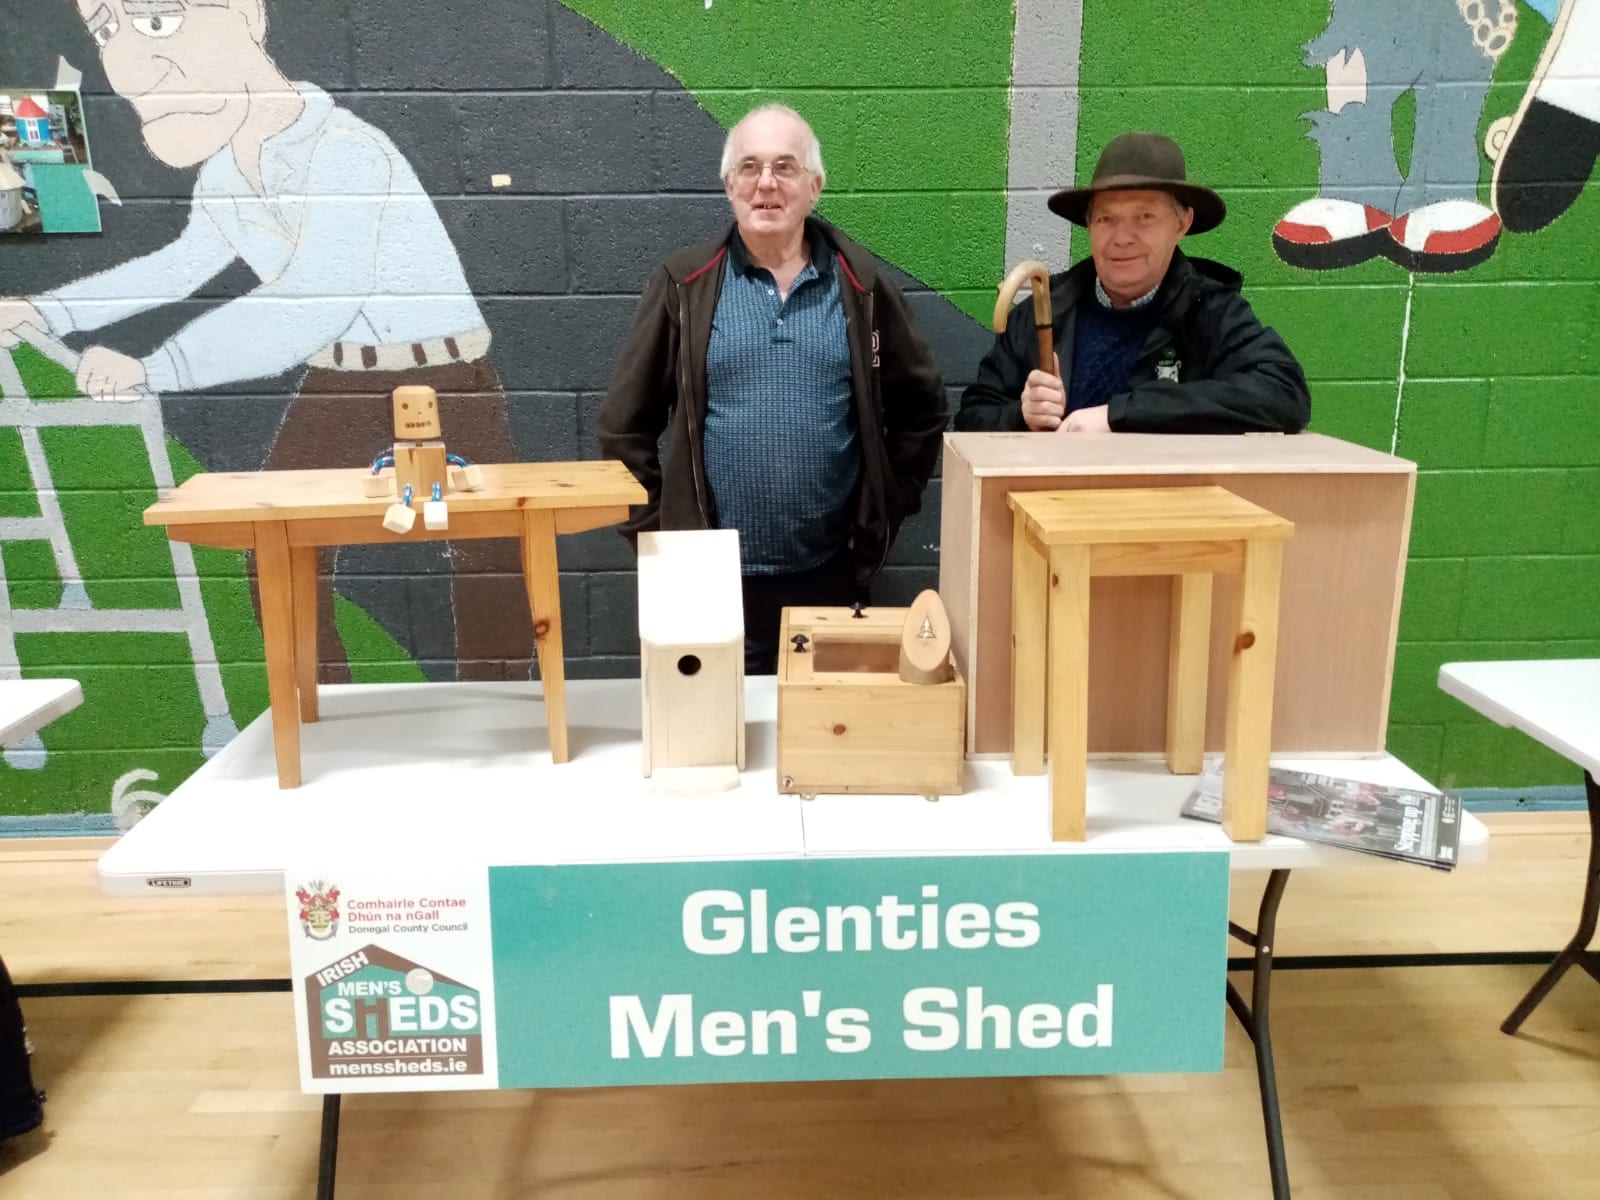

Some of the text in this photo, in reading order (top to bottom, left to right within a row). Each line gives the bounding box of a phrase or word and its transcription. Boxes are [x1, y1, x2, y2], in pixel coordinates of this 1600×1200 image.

[346, 897, 467, 910] Comhairle Contae
[347, 910, 440, 922] Dhún na nGall
[682, 884, 1041, 956] Glenties
[348, 922, 468, 934] Donegal County Council
[316, 950, 370, 987] IRISH
[337, 981, 402, 996] MEN'S
[324, 995, 479, 1038] SHEDS
[609, 983, 1114, 1060] Men's Shed
[328, 1038, 468, 1055] ASSOCIATION
[329, 1057, 468, 1075] menssheds.ie
